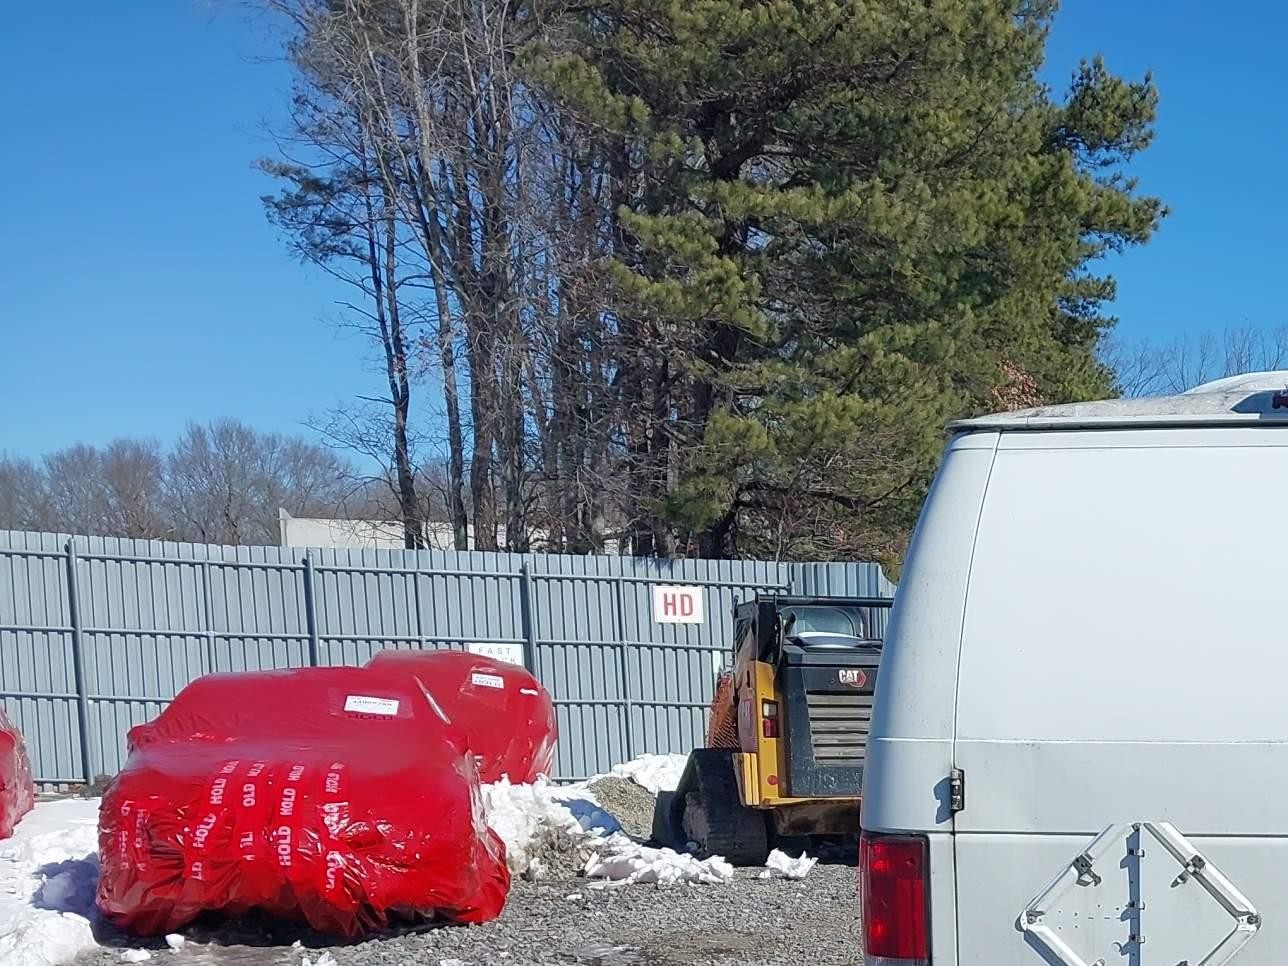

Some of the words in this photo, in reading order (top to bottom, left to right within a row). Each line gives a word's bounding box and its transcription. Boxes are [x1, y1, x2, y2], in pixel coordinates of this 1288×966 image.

[663, 593, 694, 617] HD
[838, 669, 860, 684] CAT
[209, 778, 227, 805] HOLD
[280, 788, 296, 816] HOLD
[278, 826, 292, 866] HOLD
